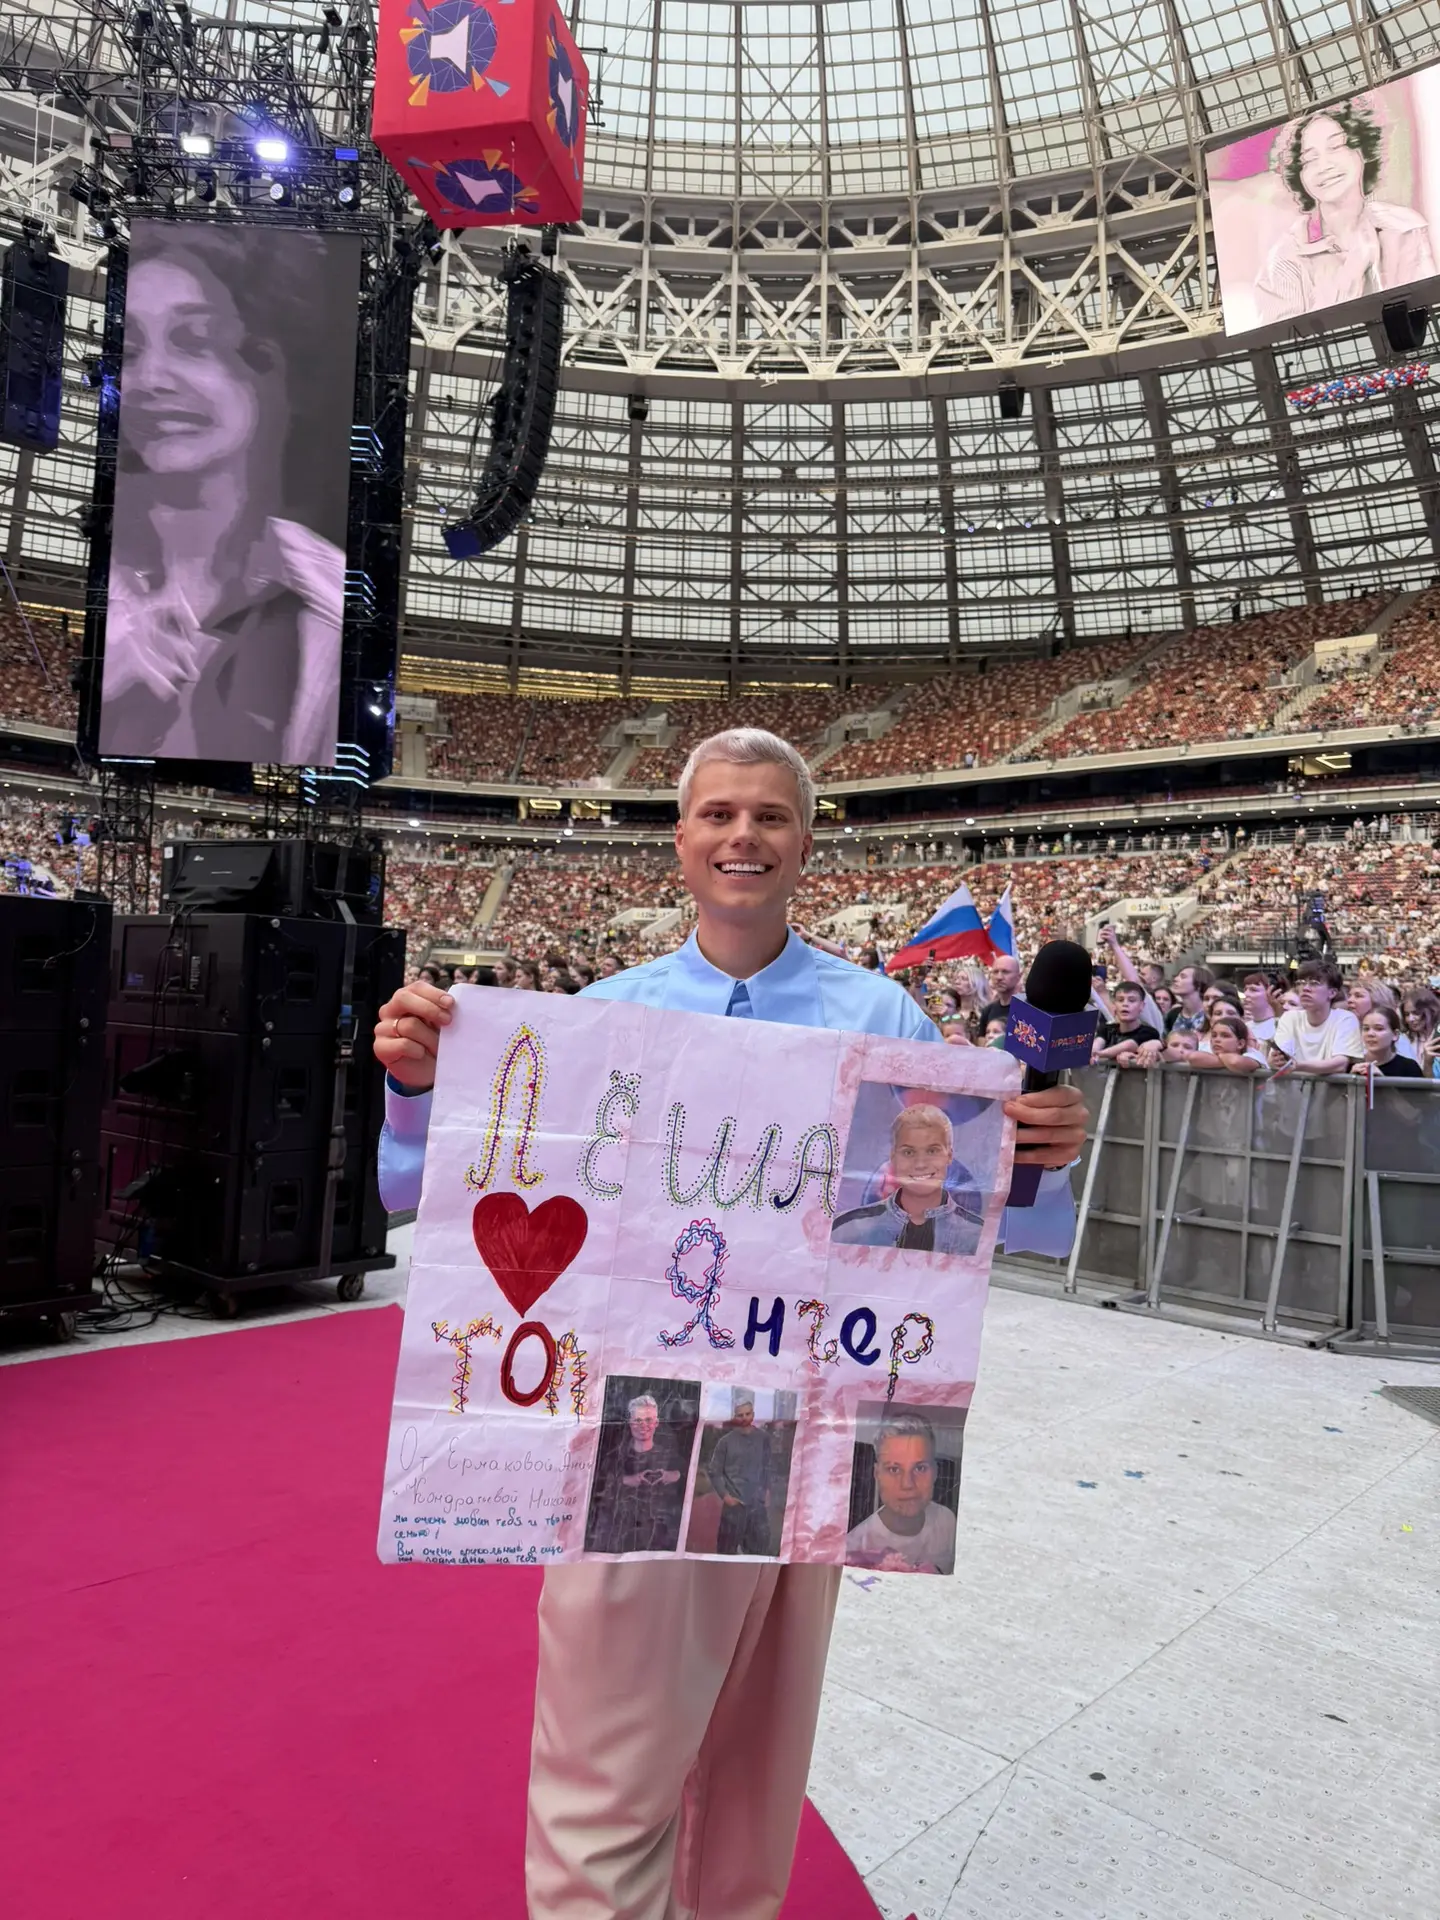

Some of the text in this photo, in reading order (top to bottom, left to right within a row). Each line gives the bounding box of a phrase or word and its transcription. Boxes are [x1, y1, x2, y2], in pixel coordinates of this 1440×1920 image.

[399, 1426, 430, 1473] От
[447, 1436, 553, 1476] Ермаковой
[414, 1515, 447, 1526] очень
[453, 1508, 490, 1527] любим
[496, 1506, 523, 1527] тебя
[397, 1541, 414, 1557] Вы
